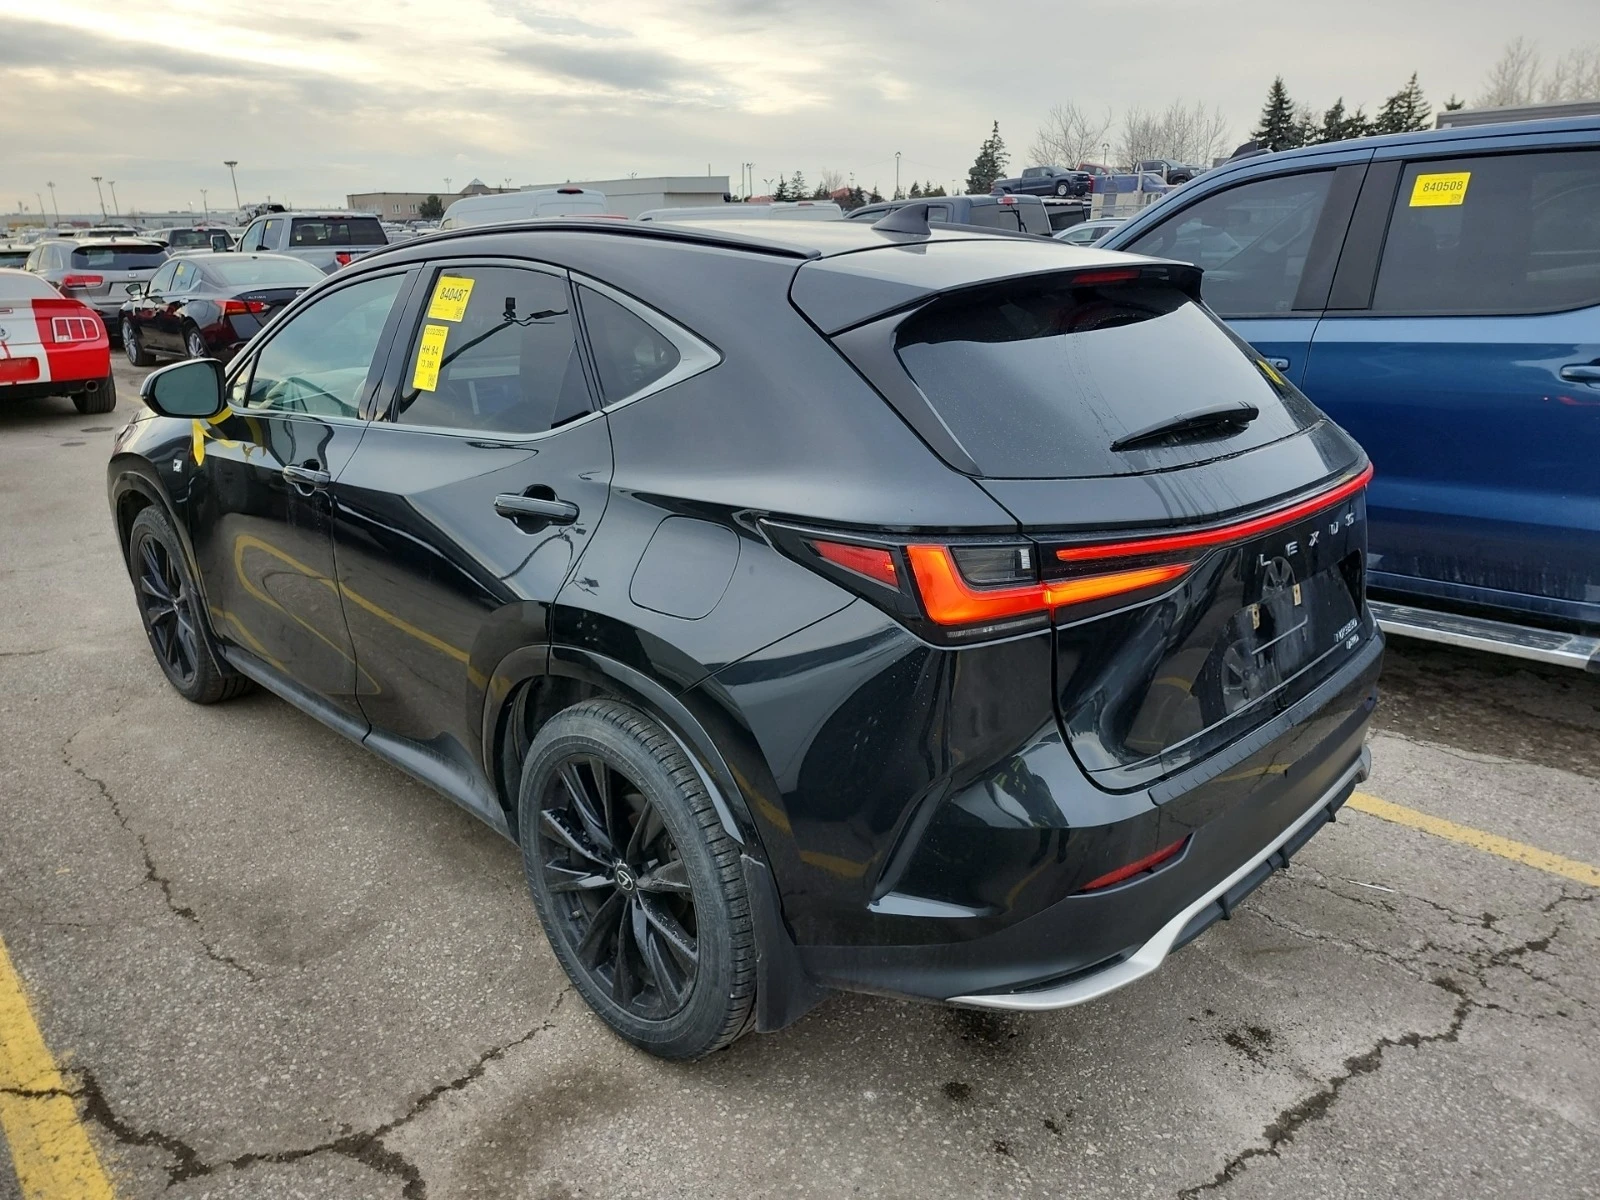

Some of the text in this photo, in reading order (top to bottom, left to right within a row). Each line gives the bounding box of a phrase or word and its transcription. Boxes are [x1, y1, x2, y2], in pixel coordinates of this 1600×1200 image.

[1423, 181, 1463, 192] 840508
[440, 287, 468, 302] 840487
[1259, 512, 1354, 566] LEXUS
